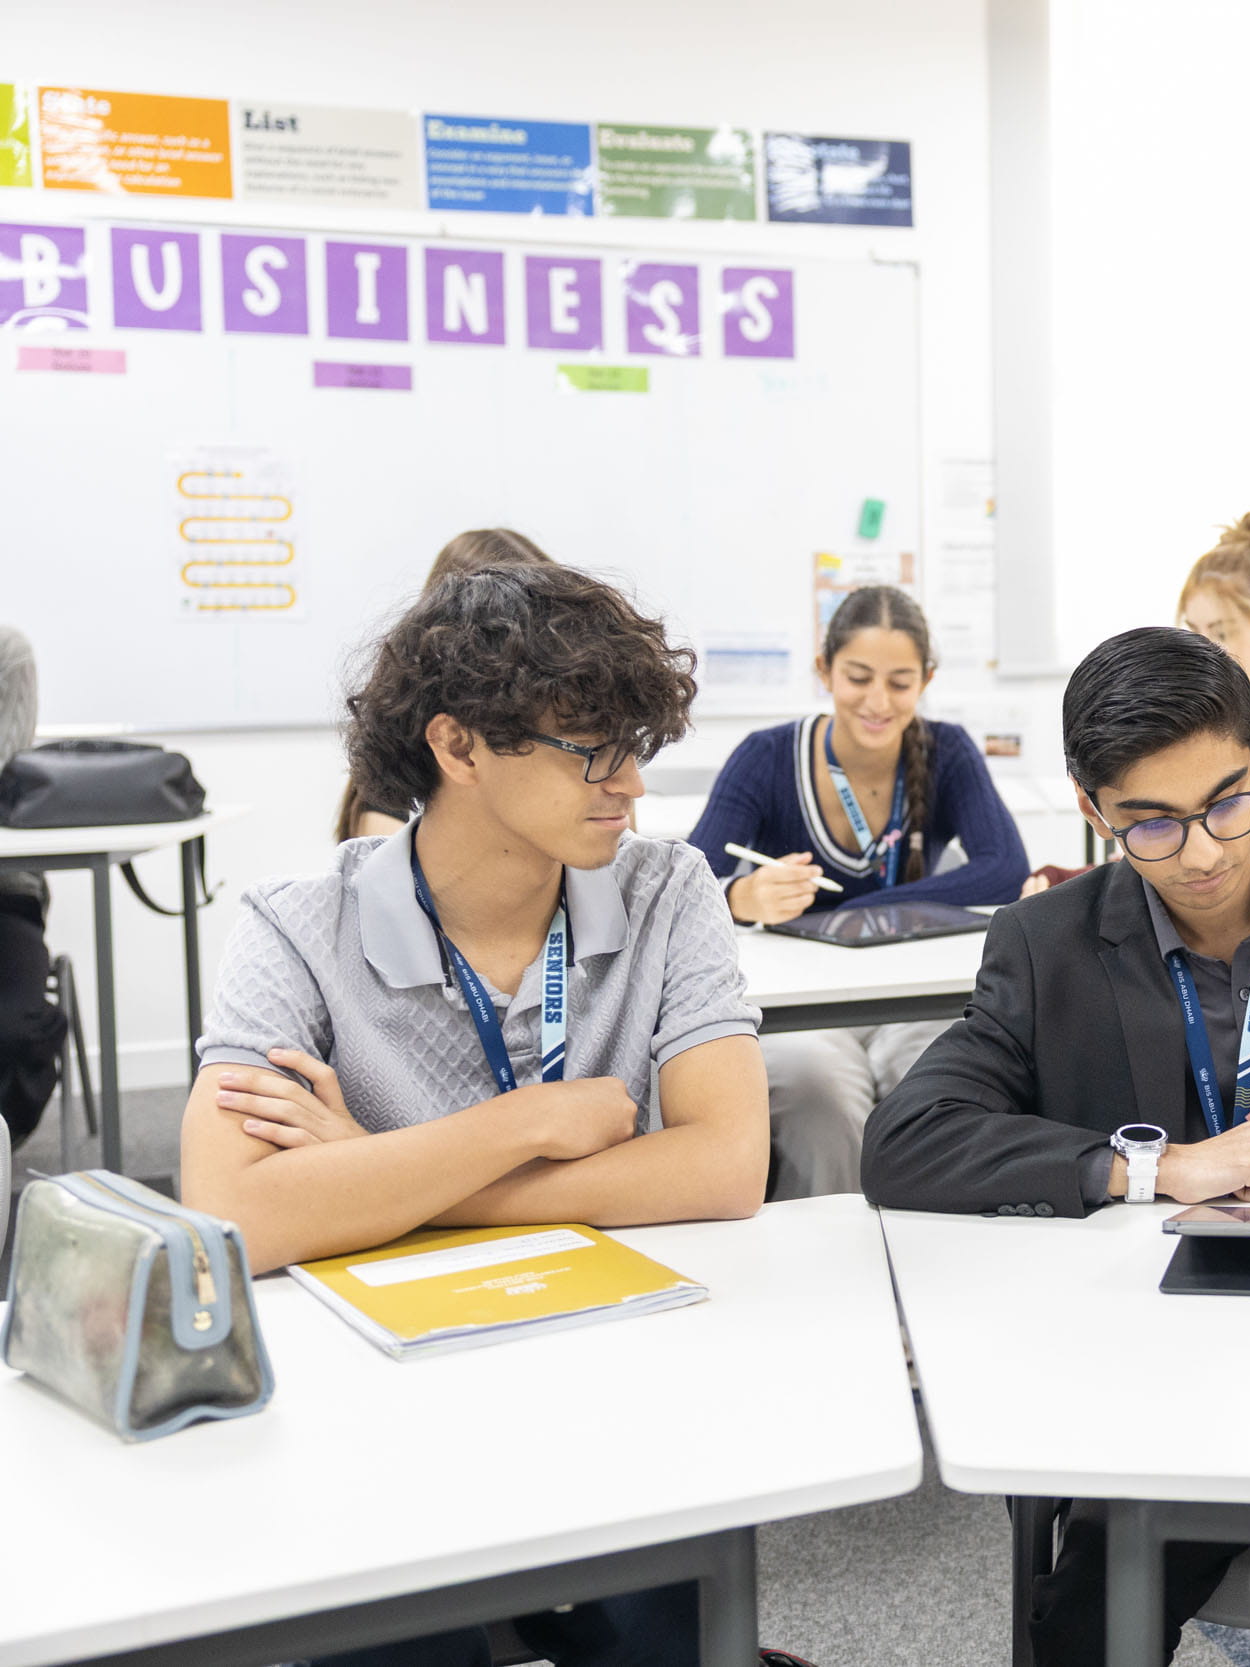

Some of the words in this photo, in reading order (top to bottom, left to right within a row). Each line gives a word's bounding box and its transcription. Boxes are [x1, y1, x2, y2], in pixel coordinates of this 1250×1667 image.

[244, 110, 298, 132] List
[428, 118, 528, 146] Examine
[600, 128, 696, 153] Evaluate
[544, 931, 564, 1024] SENIORS
[1176, 970, 1185, 984] BIS
[461, 967, 472, 983] BIS
[468, 981, 480, 998] ABU
[475, 997, 490, 1023] DHABI
[1180, 984, 1189, 1002] ABU
[1184, 1001, 1195, 1025] DHABI
[1203, 1084, 1212, 1098] BIS
[1207, 1098, 1216, 1117] ABU
[1212, 1115, 1221, 1136] DHAB
